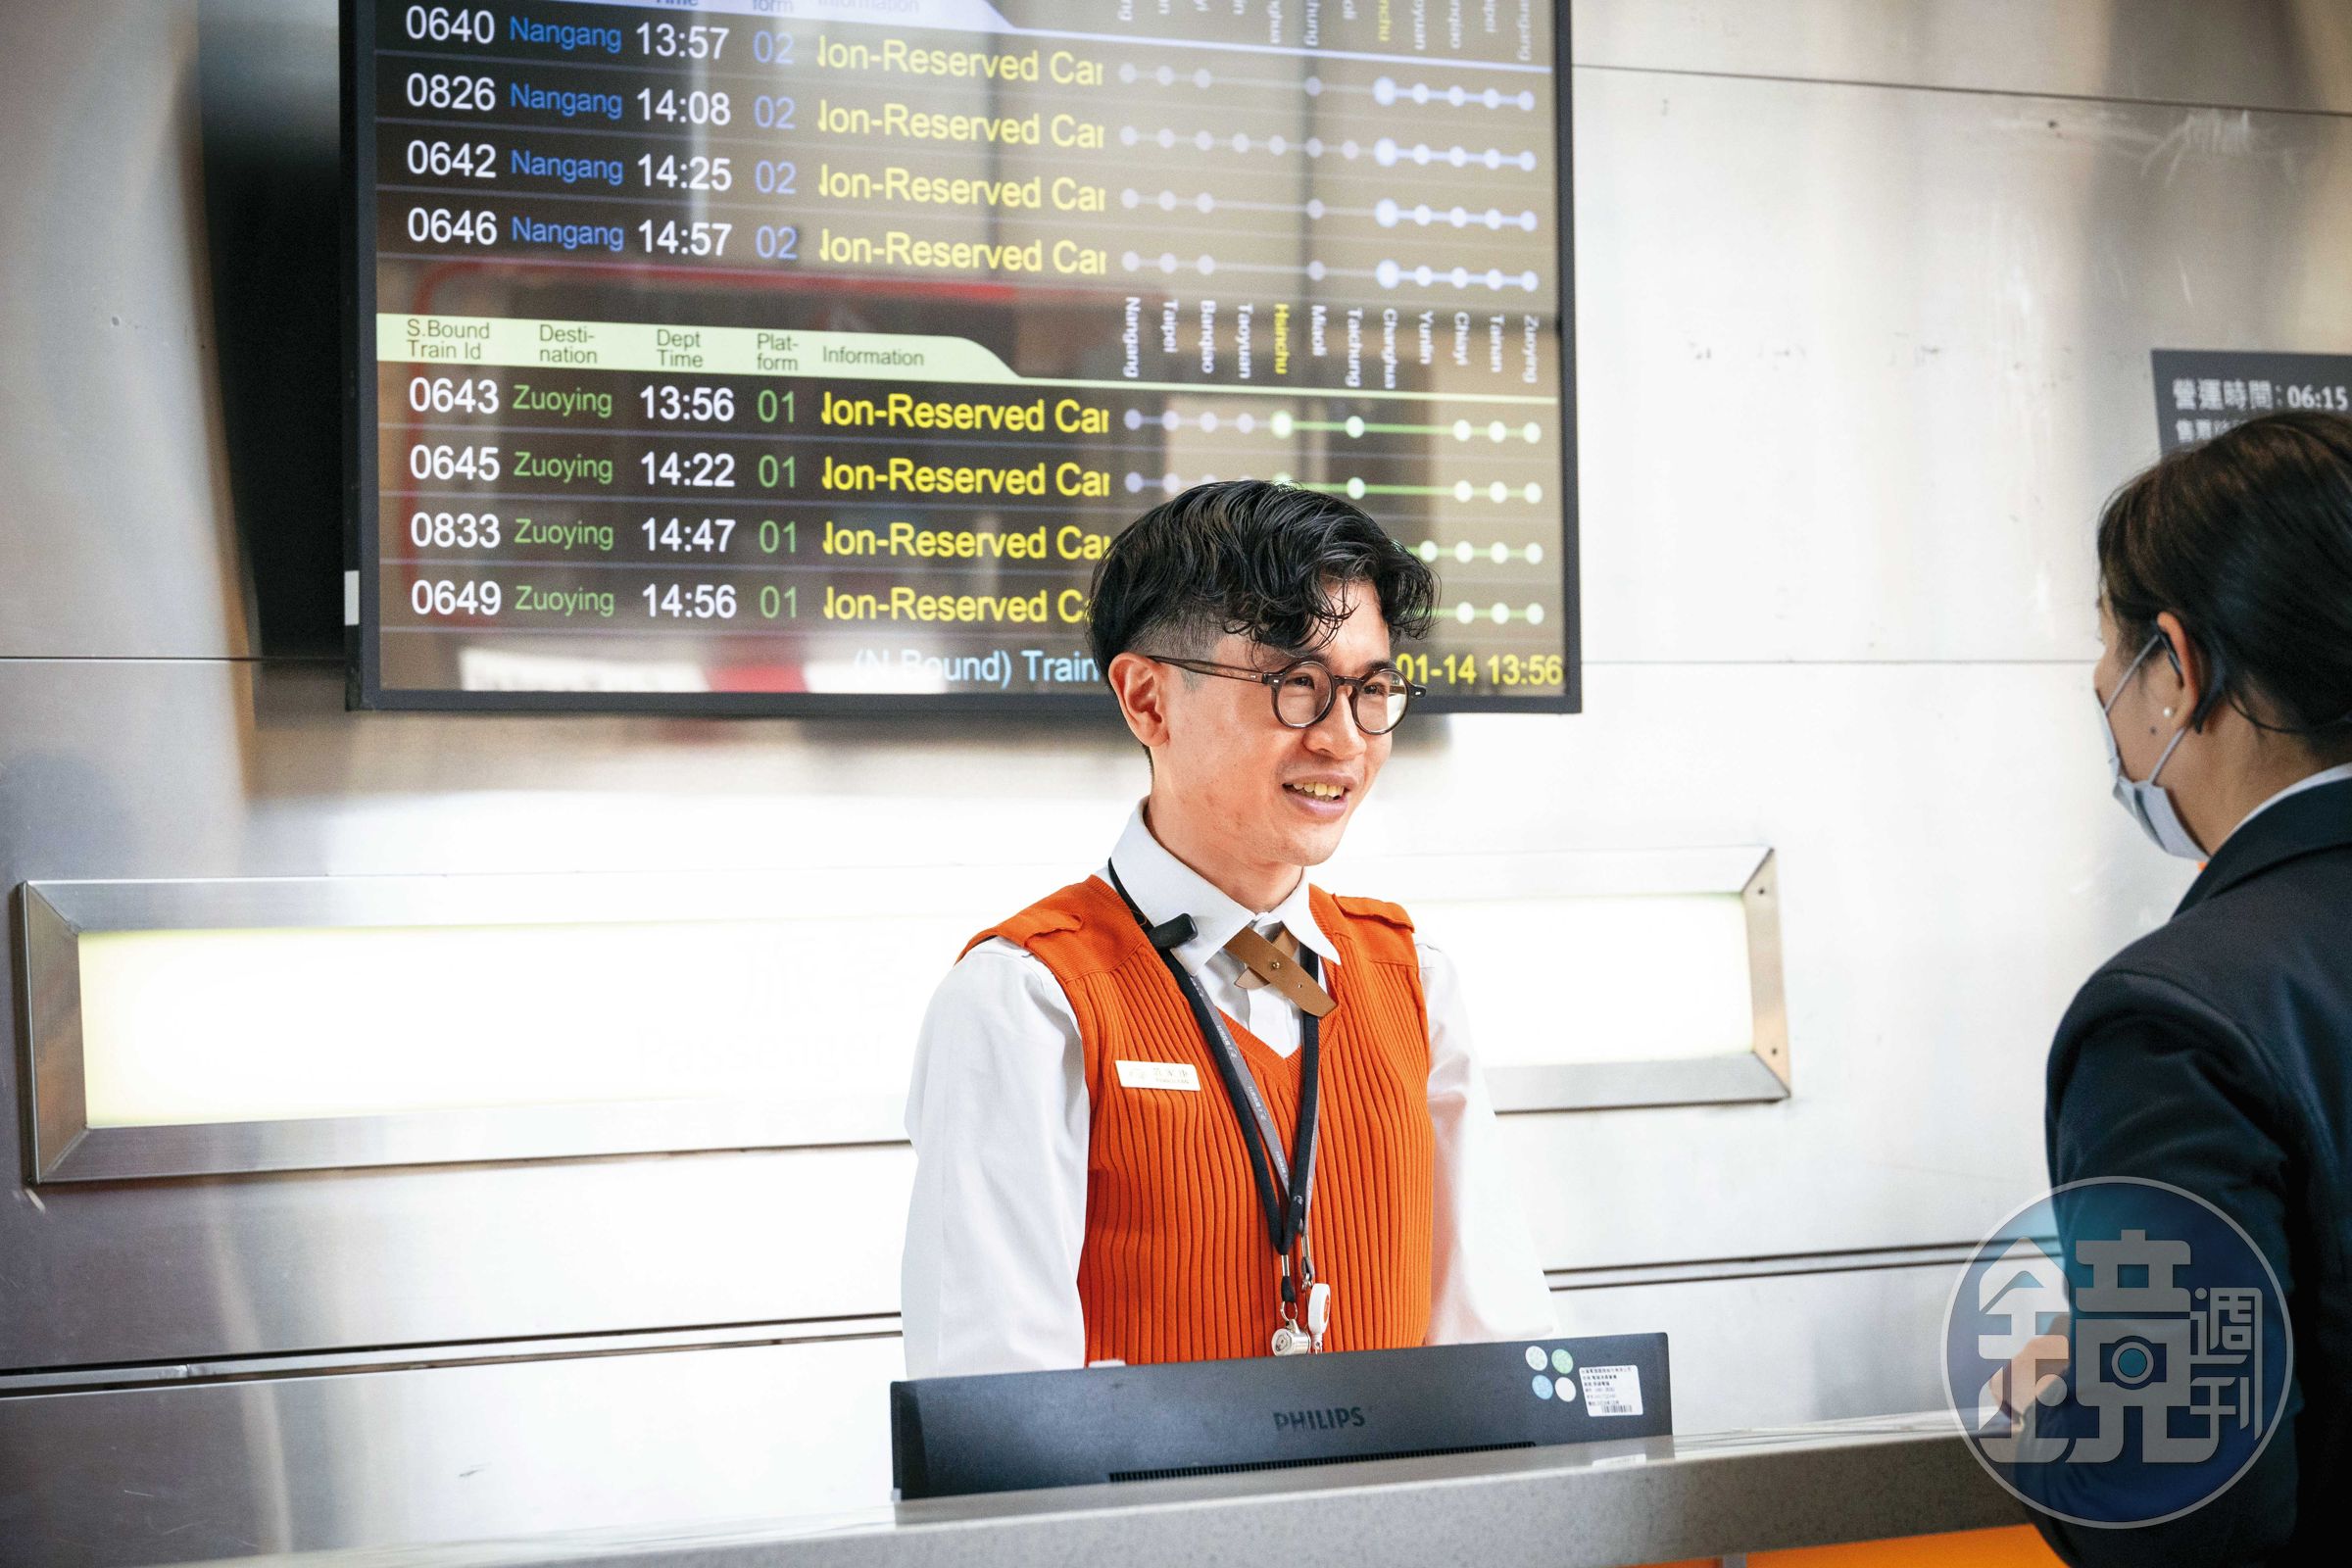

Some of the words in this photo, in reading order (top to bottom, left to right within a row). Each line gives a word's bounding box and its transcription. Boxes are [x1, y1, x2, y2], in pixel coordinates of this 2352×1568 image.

[407, 6, 494, 44] 0640
[510, 16, 621, 54] Nangang
[637, 23, 730, 59] 13:57
[753, 30, 794, 64] 02
[407, 74, 495, 111] 0826
[510, 82, 622, 120] Nangang
[638, 88, 732, 126] 14:08
[754, 94, 796, 129] 02
[408, 140, 496, 177] 0642
[511, 150, 624, 186] Nangang
[639, 154, 733, 192] 14:25
[755, 160, 796, 194] 02
[408, 208, 497, 245] 0646
[512, 217, 624, 251] Nangang
[639, 218, 733, 257] 14:57
[756, 224, 798, 260] 02
[407, 318, 490, 339] S.Bound
[407, 339, 457, 359] Train
[465, 342, 481, 360] Id
[539, 324, 595, 343] Desti-
[657, 328, 701, 350] Dept
[757, 332, 799, 351] Plat-
[1122, 297, 1141, 378] Nangang
[1160, 299, 1179, 354] Taipei
[1199, 300, 1216, 374] Banqiao
[1235, 303, 1253, 379] Taoyuan
[1275, 303, 1290, 374] Hsinchu
[1311, 305, 1327, 357] Miaoli
[1346, 308, 1363, 387] Taichung
[1381, 308, 1398, 389] Changhua
[1419, 311, 1434, 366] Yunlin
[1452, 312, 1470, 366] Chiayi
[1490, 315, 1505, 372] Tainan
[1522, 315, 1540, 383] Zuoying
[539, 347, 598, 364] nation
[657, 349, 704, 368] Time
[757, 353, 799, 370] form
[823, 346, 925, 366] Information
[410, 377, 499, 414] 0643
[513, 384, 612, 417] Zuoying
[641, 386, 734, 421] 13:56
[758, 390, 794, 423] 01
[411, 445, 499, 480] 0645
[514, 451, 612, 485] Zuoying
[642, 452, 734, 486] 14:22
[759, 455, 795, 487] 01
[412, 513, 500, 548] 0833
[514, 517, 613, 551] Zuoying
[643, 518, 735, 552] 14:47
[760, 519, 796, 555] 01
[413, 580, 501, 614] 0649
[516, 584, 614, 616] Zuoying
[643, 584, 736, 618] 14:56
[760, 584, 797, 618] 01
[1488, 654, 1564, 686] 13:56
[1273, 1406, 1365, 1431] PHILIPS
